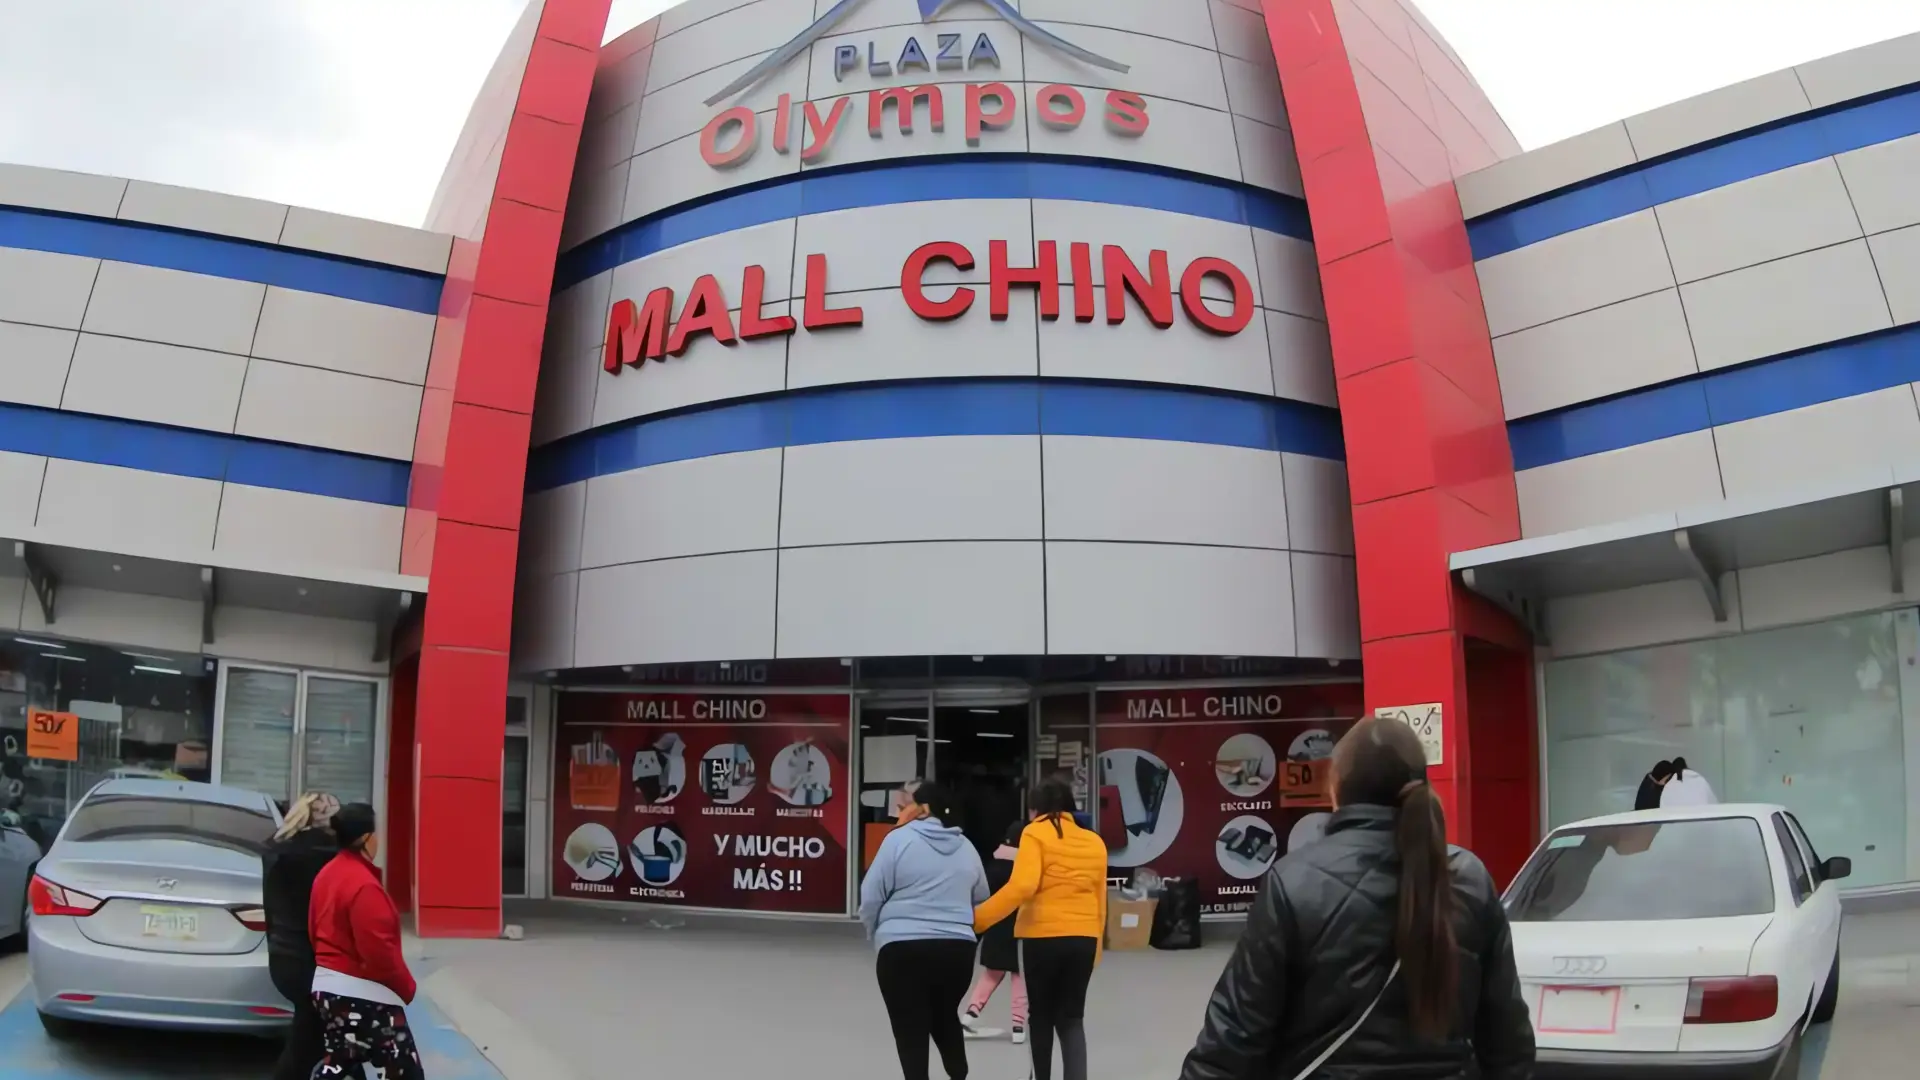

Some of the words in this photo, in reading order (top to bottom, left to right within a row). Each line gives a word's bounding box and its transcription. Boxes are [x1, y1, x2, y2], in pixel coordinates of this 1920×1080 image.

[834, 32, 1000, 82] PLAZA
[699, 82, 1150, 168] Olympos
[603, 253, 864, 375] MALL
[900, 239, 1255, 337] CHINO
[627, 700, 686, 720] MALL
[692, 699, 767, 720] CHINO
[1127, 697, 1197, 720] MALL
[1203, 694, 1282, 717] CHINO
[713, 833, 730, 856] Y
[735, 834, 825, 859] MUCHO
